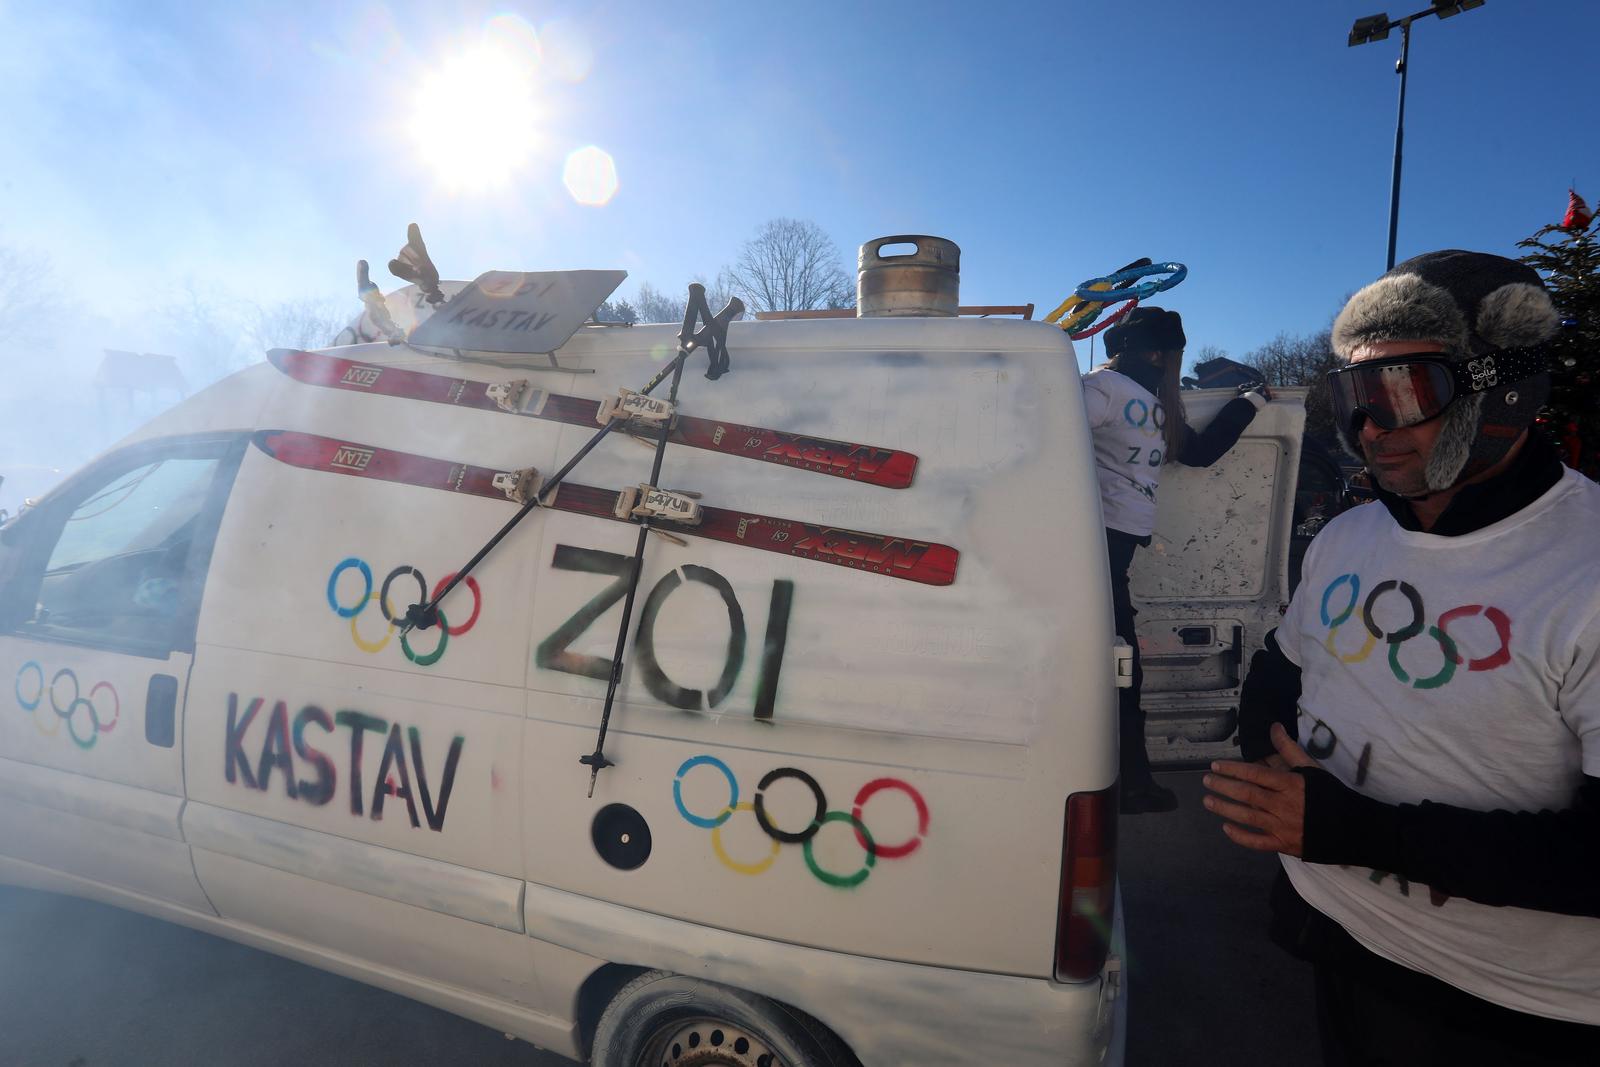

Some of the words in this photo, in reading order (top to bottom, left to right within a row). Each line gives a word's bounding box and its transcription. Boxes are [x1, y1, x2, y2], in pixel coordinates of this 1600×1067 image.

[447, 306, 558, 332] KASTAV
[341, 366, 382, 386] ELAN
[333, 447, 374, 468] ELAN
[535, 543, 794, 724] ZOI
[223, 691, 465, 834] KASTAV
[1302, 712, 1372, 787] OI
